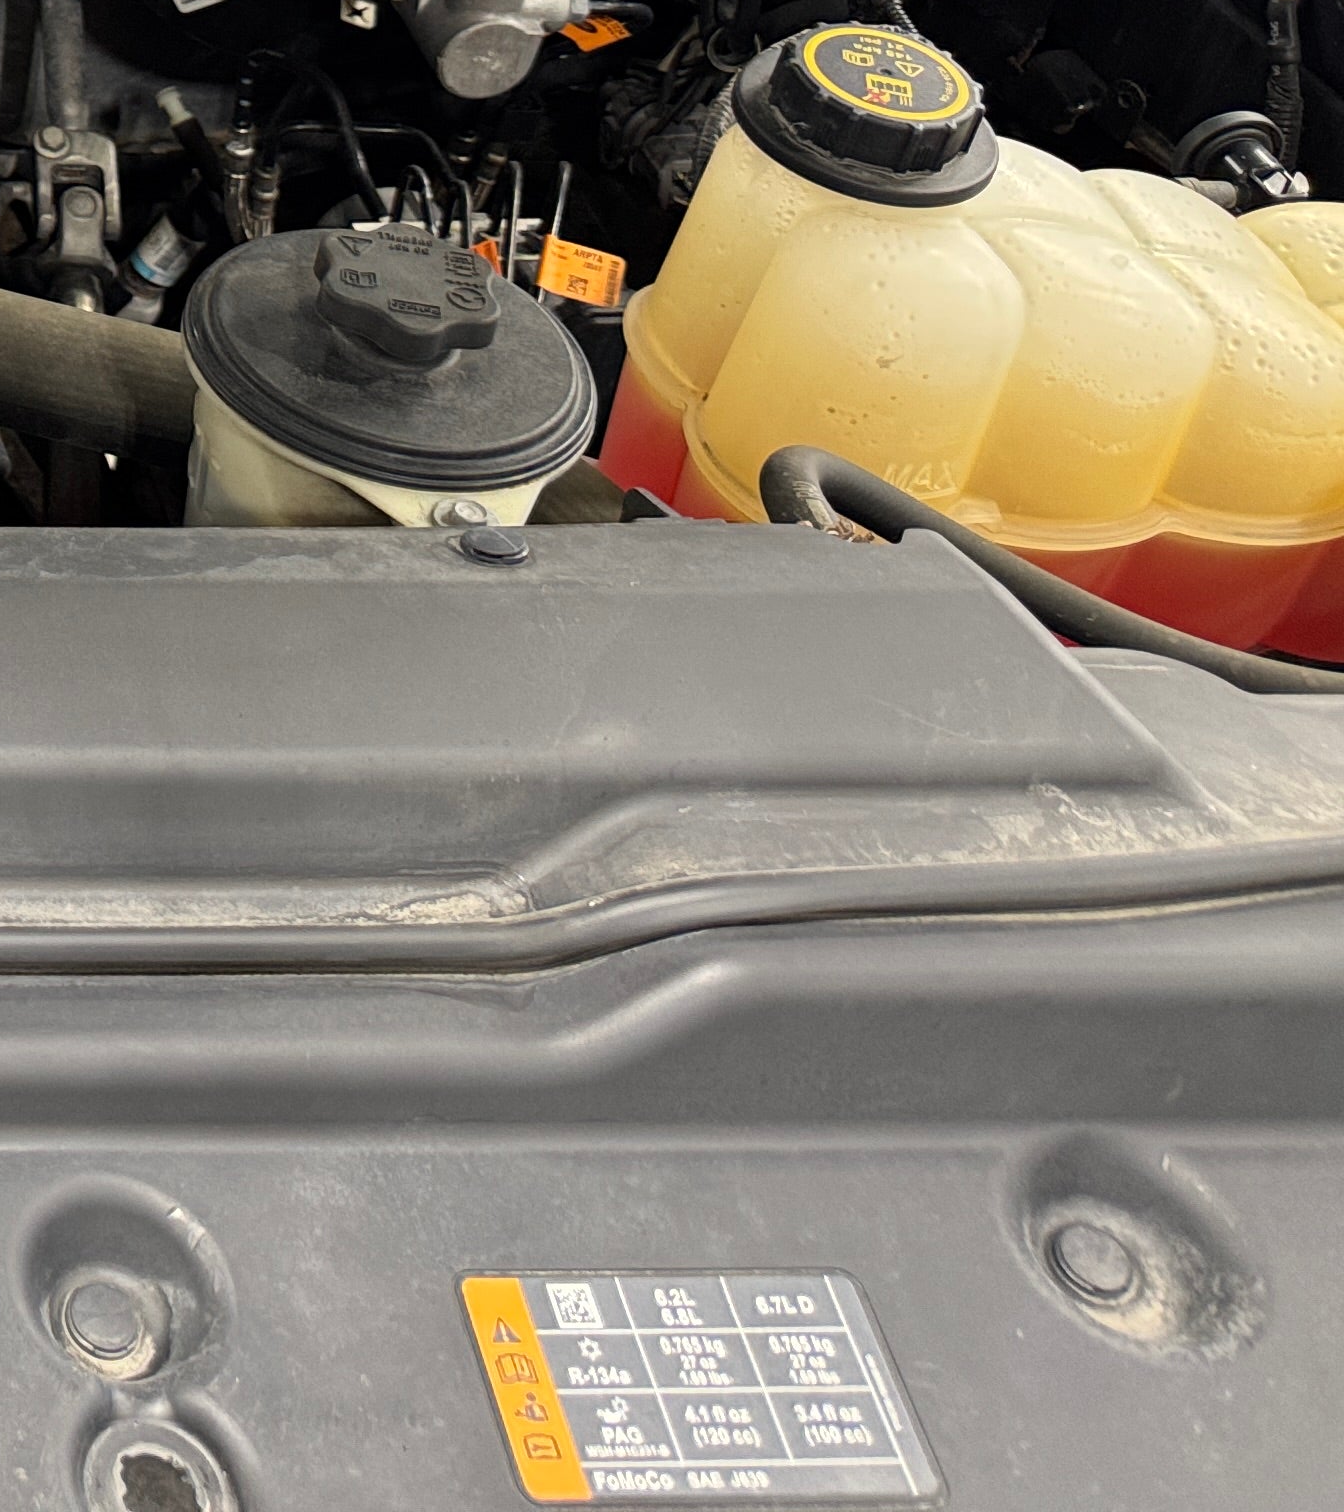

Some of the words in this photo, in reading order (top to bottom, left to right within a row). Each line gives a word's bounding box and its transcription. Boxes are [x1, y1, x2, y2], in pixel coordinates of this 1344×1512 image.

[654, 1288, 697, 1307] 6.2L
[755, 1295, 798, 1315] 6.7L
[797, 1295, 815, 1314] D
[701, 1336, 727, 1358] kg
[810, 1335, 836, 1357] kg
[680, 1354, 697, 1370] 27
[567, 1366, 633, 1385] R-134a
[727, 1407, 752, 1424] oz
[838, 1406, 863, 1422] oz
[601, 1425, 645, 1445] PAG
[592, 1470, 675, 1491] FoMoCo
[686, 1470, 726, 1489] SAE
